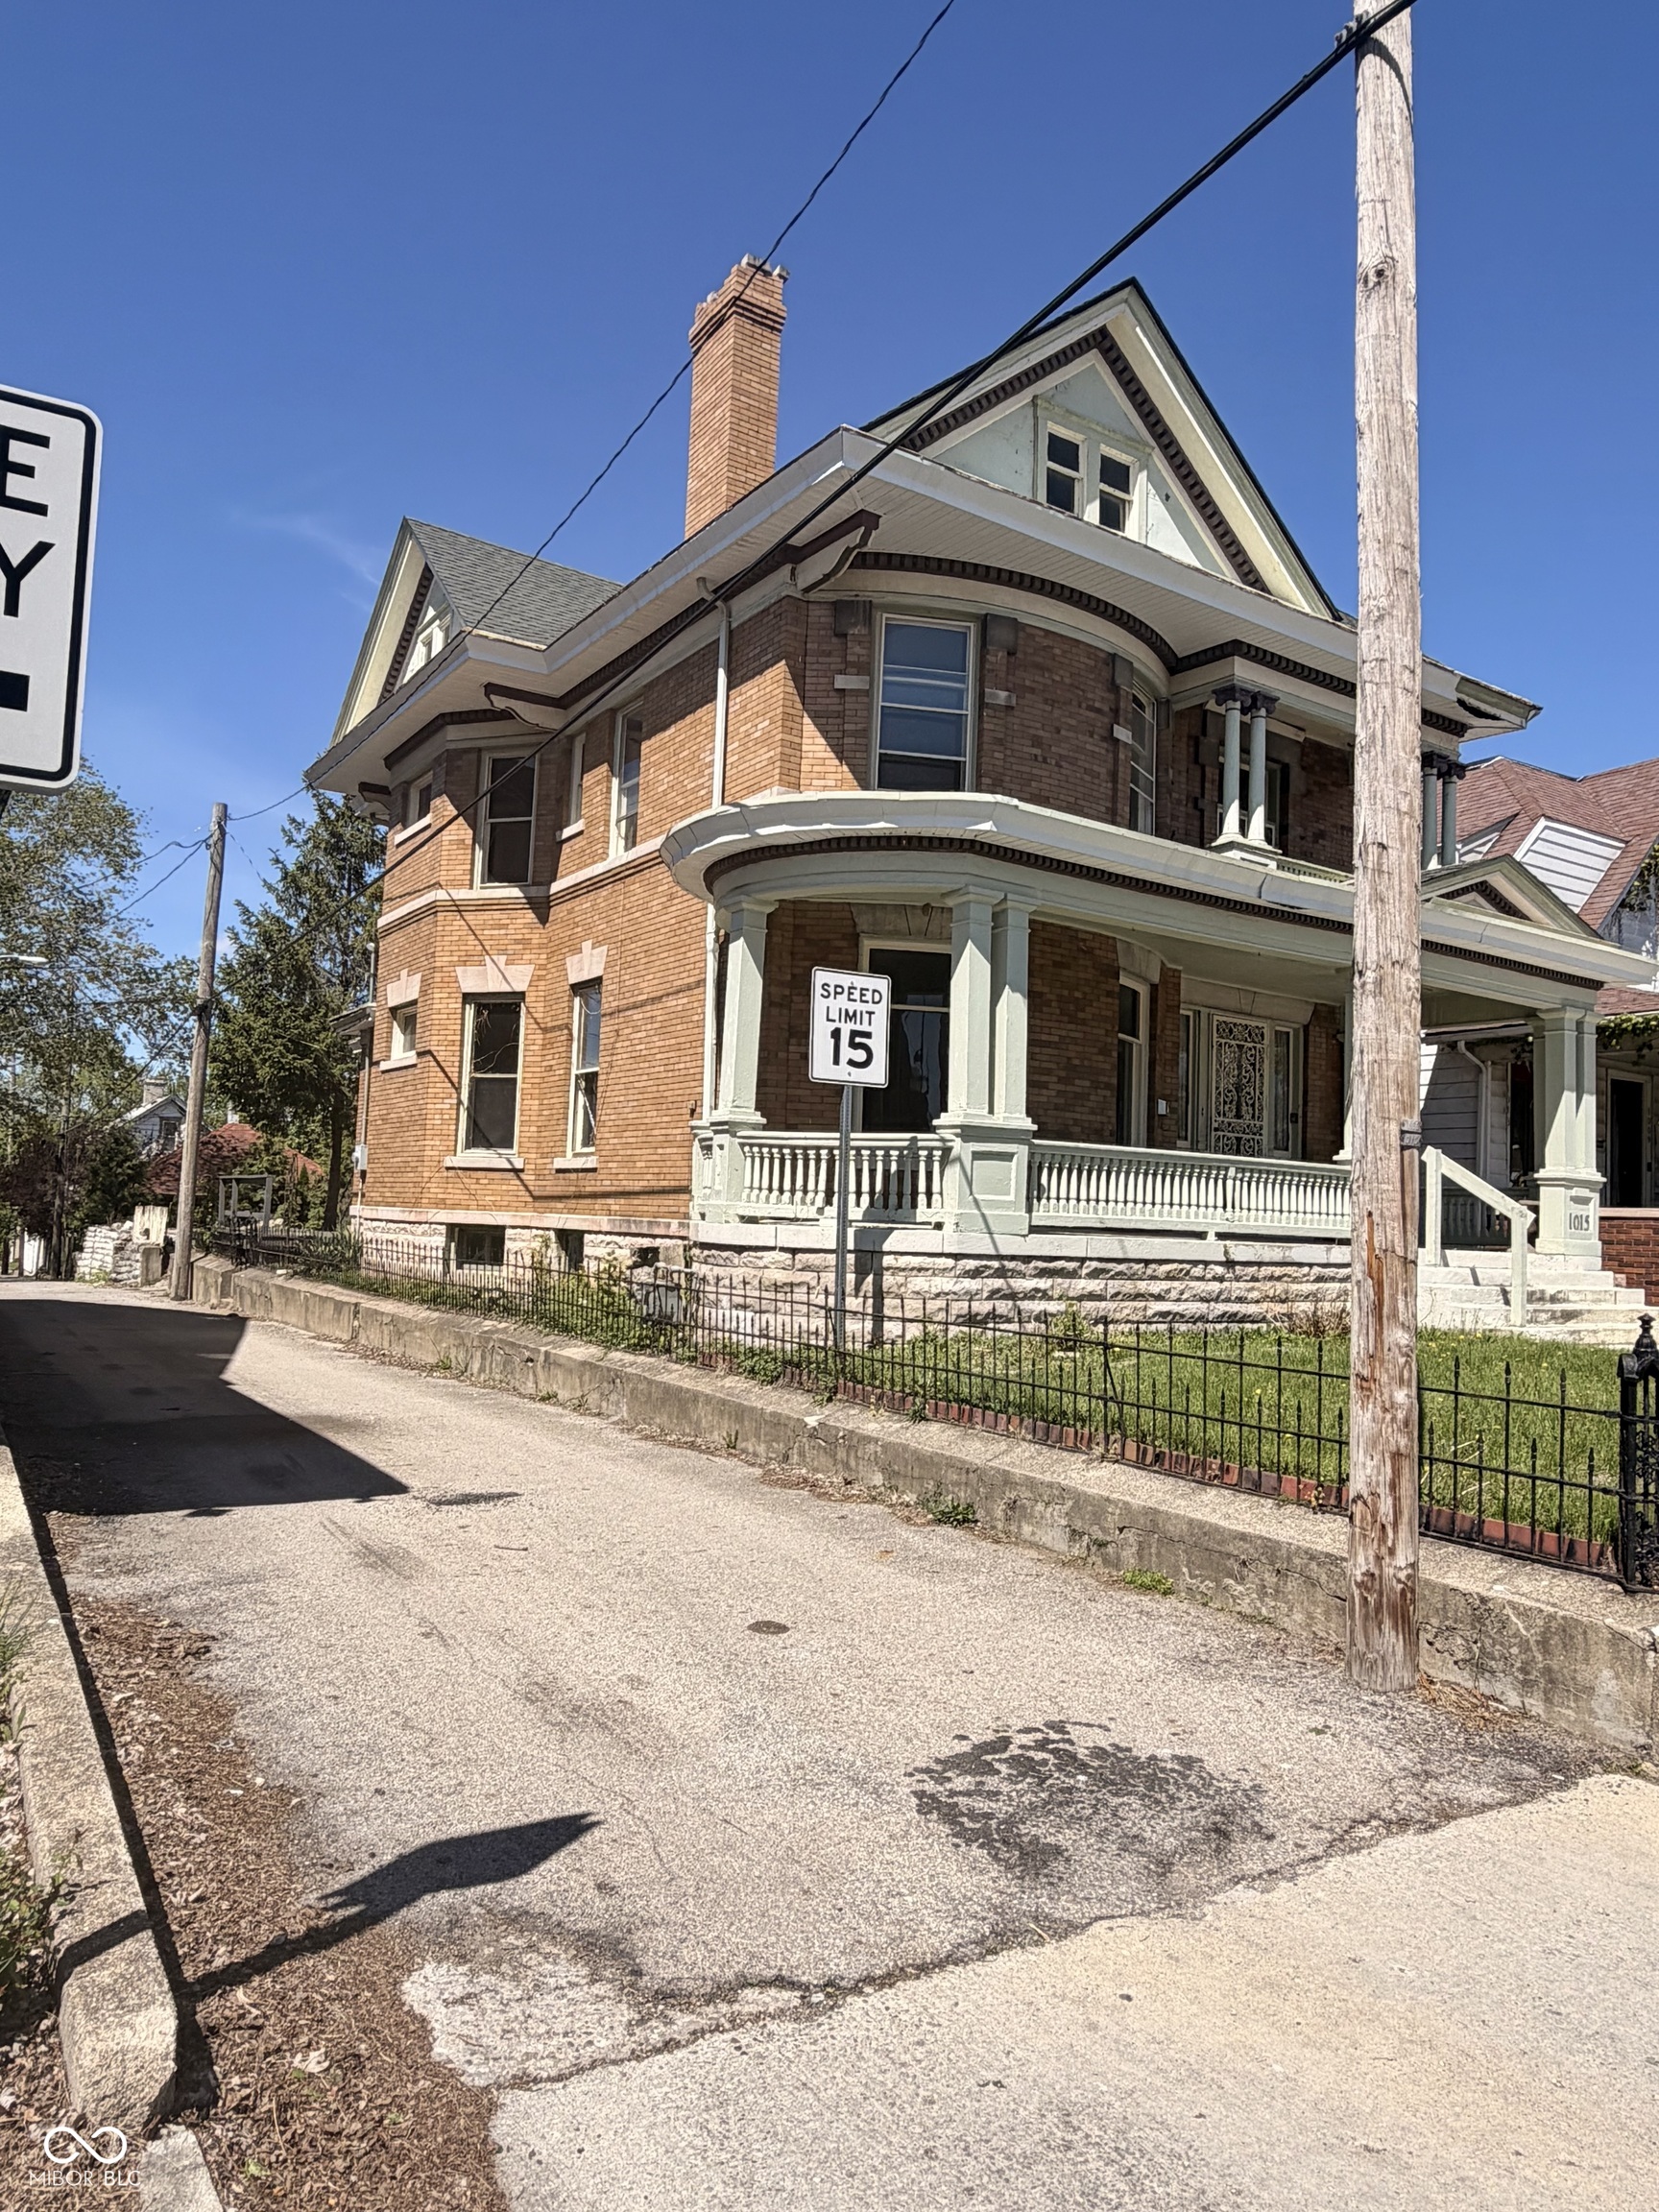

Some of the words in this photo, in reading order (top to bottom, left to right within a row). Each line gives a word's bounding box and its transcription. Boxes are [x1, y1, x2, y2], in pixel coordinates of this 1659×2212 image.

[820, 982, 882, 1004] SPEED
[826, 1006, 876, 1026] LIMIT
[830, 1026, 874, 1069] 15
[1569, 1213, 1590, 1231] 1015
